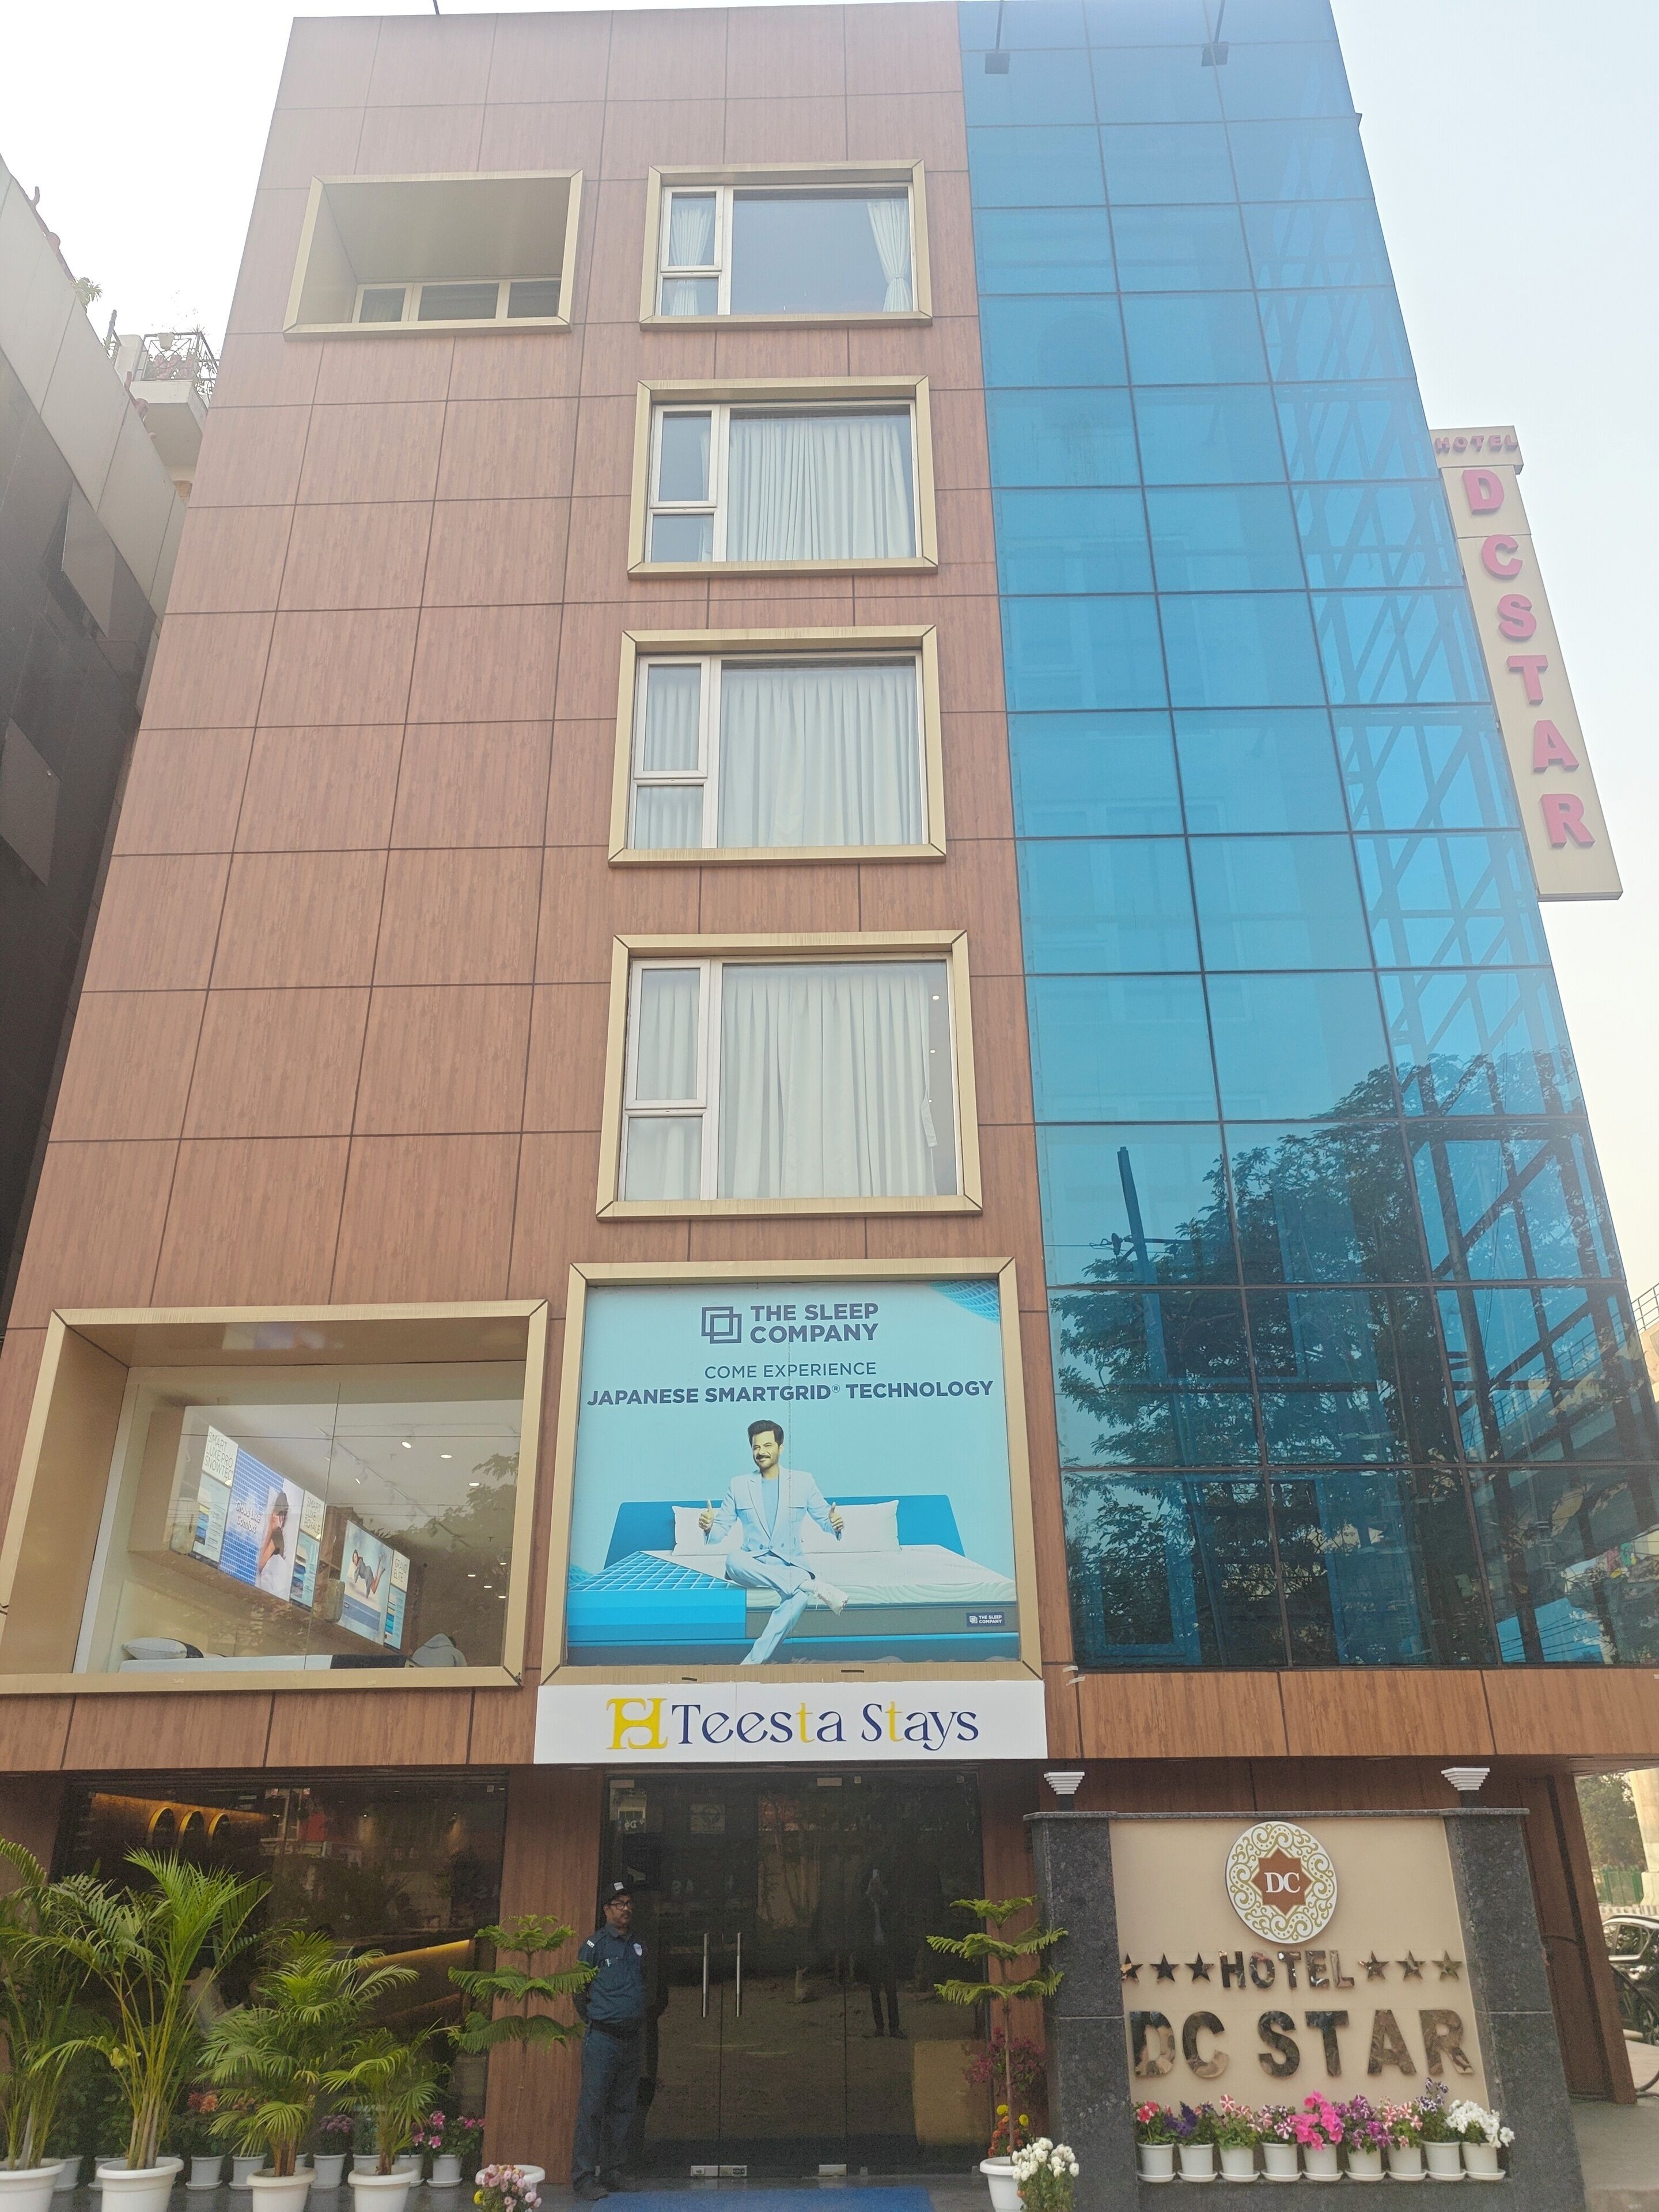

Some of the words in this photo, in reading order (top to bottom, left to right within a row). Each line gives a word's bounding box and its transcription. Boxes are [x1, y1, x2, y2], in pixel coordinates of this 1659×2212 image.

[1434, 435, 1518, 454] HOTEL
[750, 1305, 796, 1321] THE
[804, 1303, 879, 1320] SLEEP
[750, 1323, 879, 1344] COMPANY
[704, 1365, 757, 1380] COME
[763, 1362, 877, 1378] EXPERIENCE
[587, 1387, 699, 1406] JAPANESE
[846, 1380, 994, 1399] TECHNOLOGY
[208, 1432, 228, 1452] SMART
[206, 1444, 221, 1461] LUXE
[221, 1452, 233, 1468] PRO
[236, 1499, 251, 1518] Cloud
[250, 1509, 261, 1524] Like
[236, 1516, 257, 1535] Comfort
[671, 1701, 847, 1745] Teesta
[861, 1700, 979, 1751] Stays
[1264, 1872, 1301, 1893] DC
[1217, 1950, 1354, 1989] HOTEL
[1129, 2010, 1229, 2078] DC
[1257, 2009, 1475, 2076] STAR
